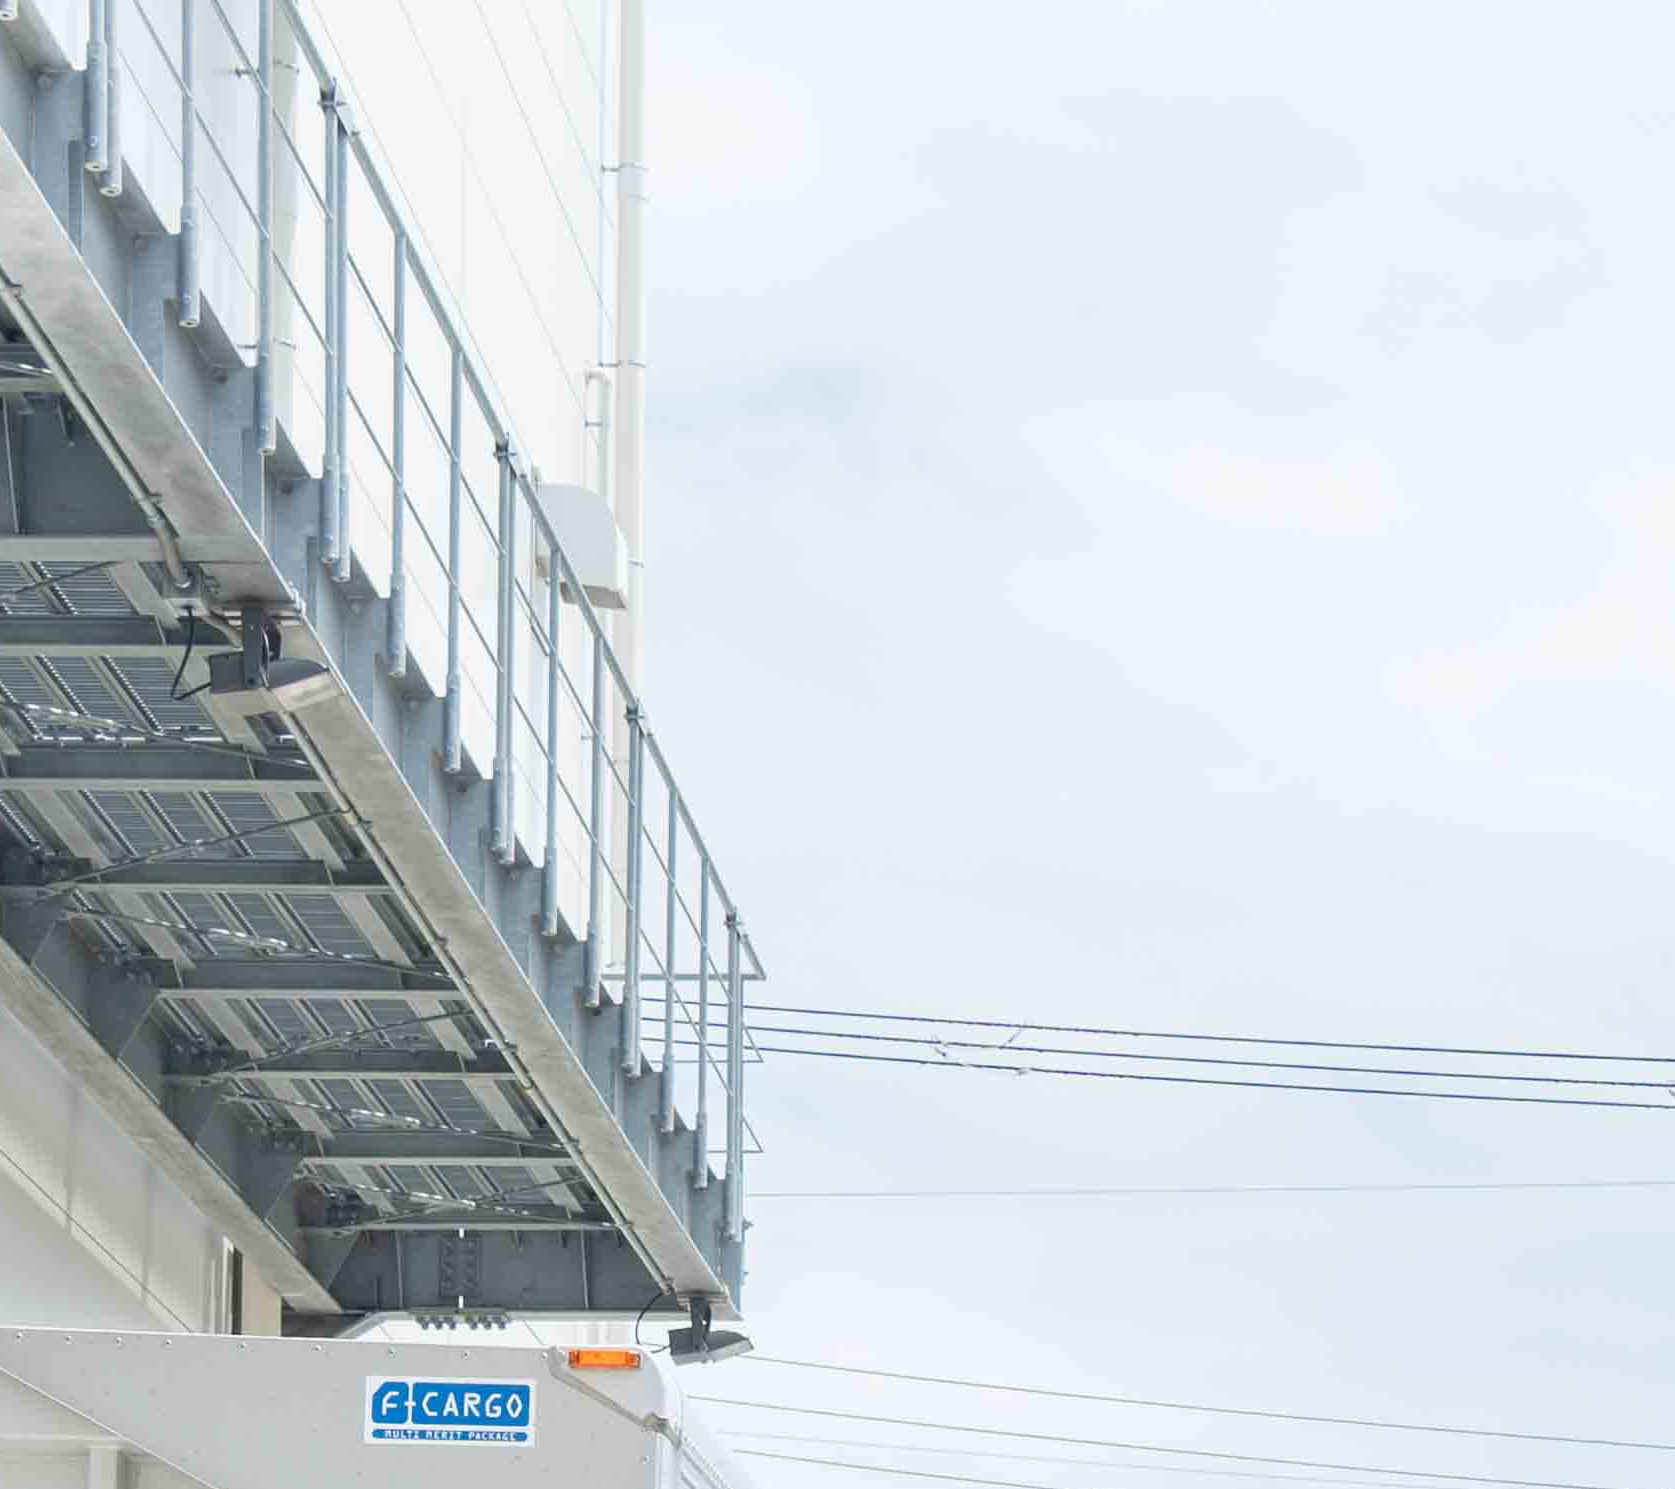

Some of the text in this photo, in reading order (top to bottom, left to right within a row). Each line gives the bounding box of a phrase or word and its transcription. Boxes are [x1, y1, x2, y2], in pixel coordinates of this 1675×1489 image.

[381, 1391, 523, 1418] F-CARGO
[385, 1430, 517, 1441] MULTI MERIT PACKAGE
